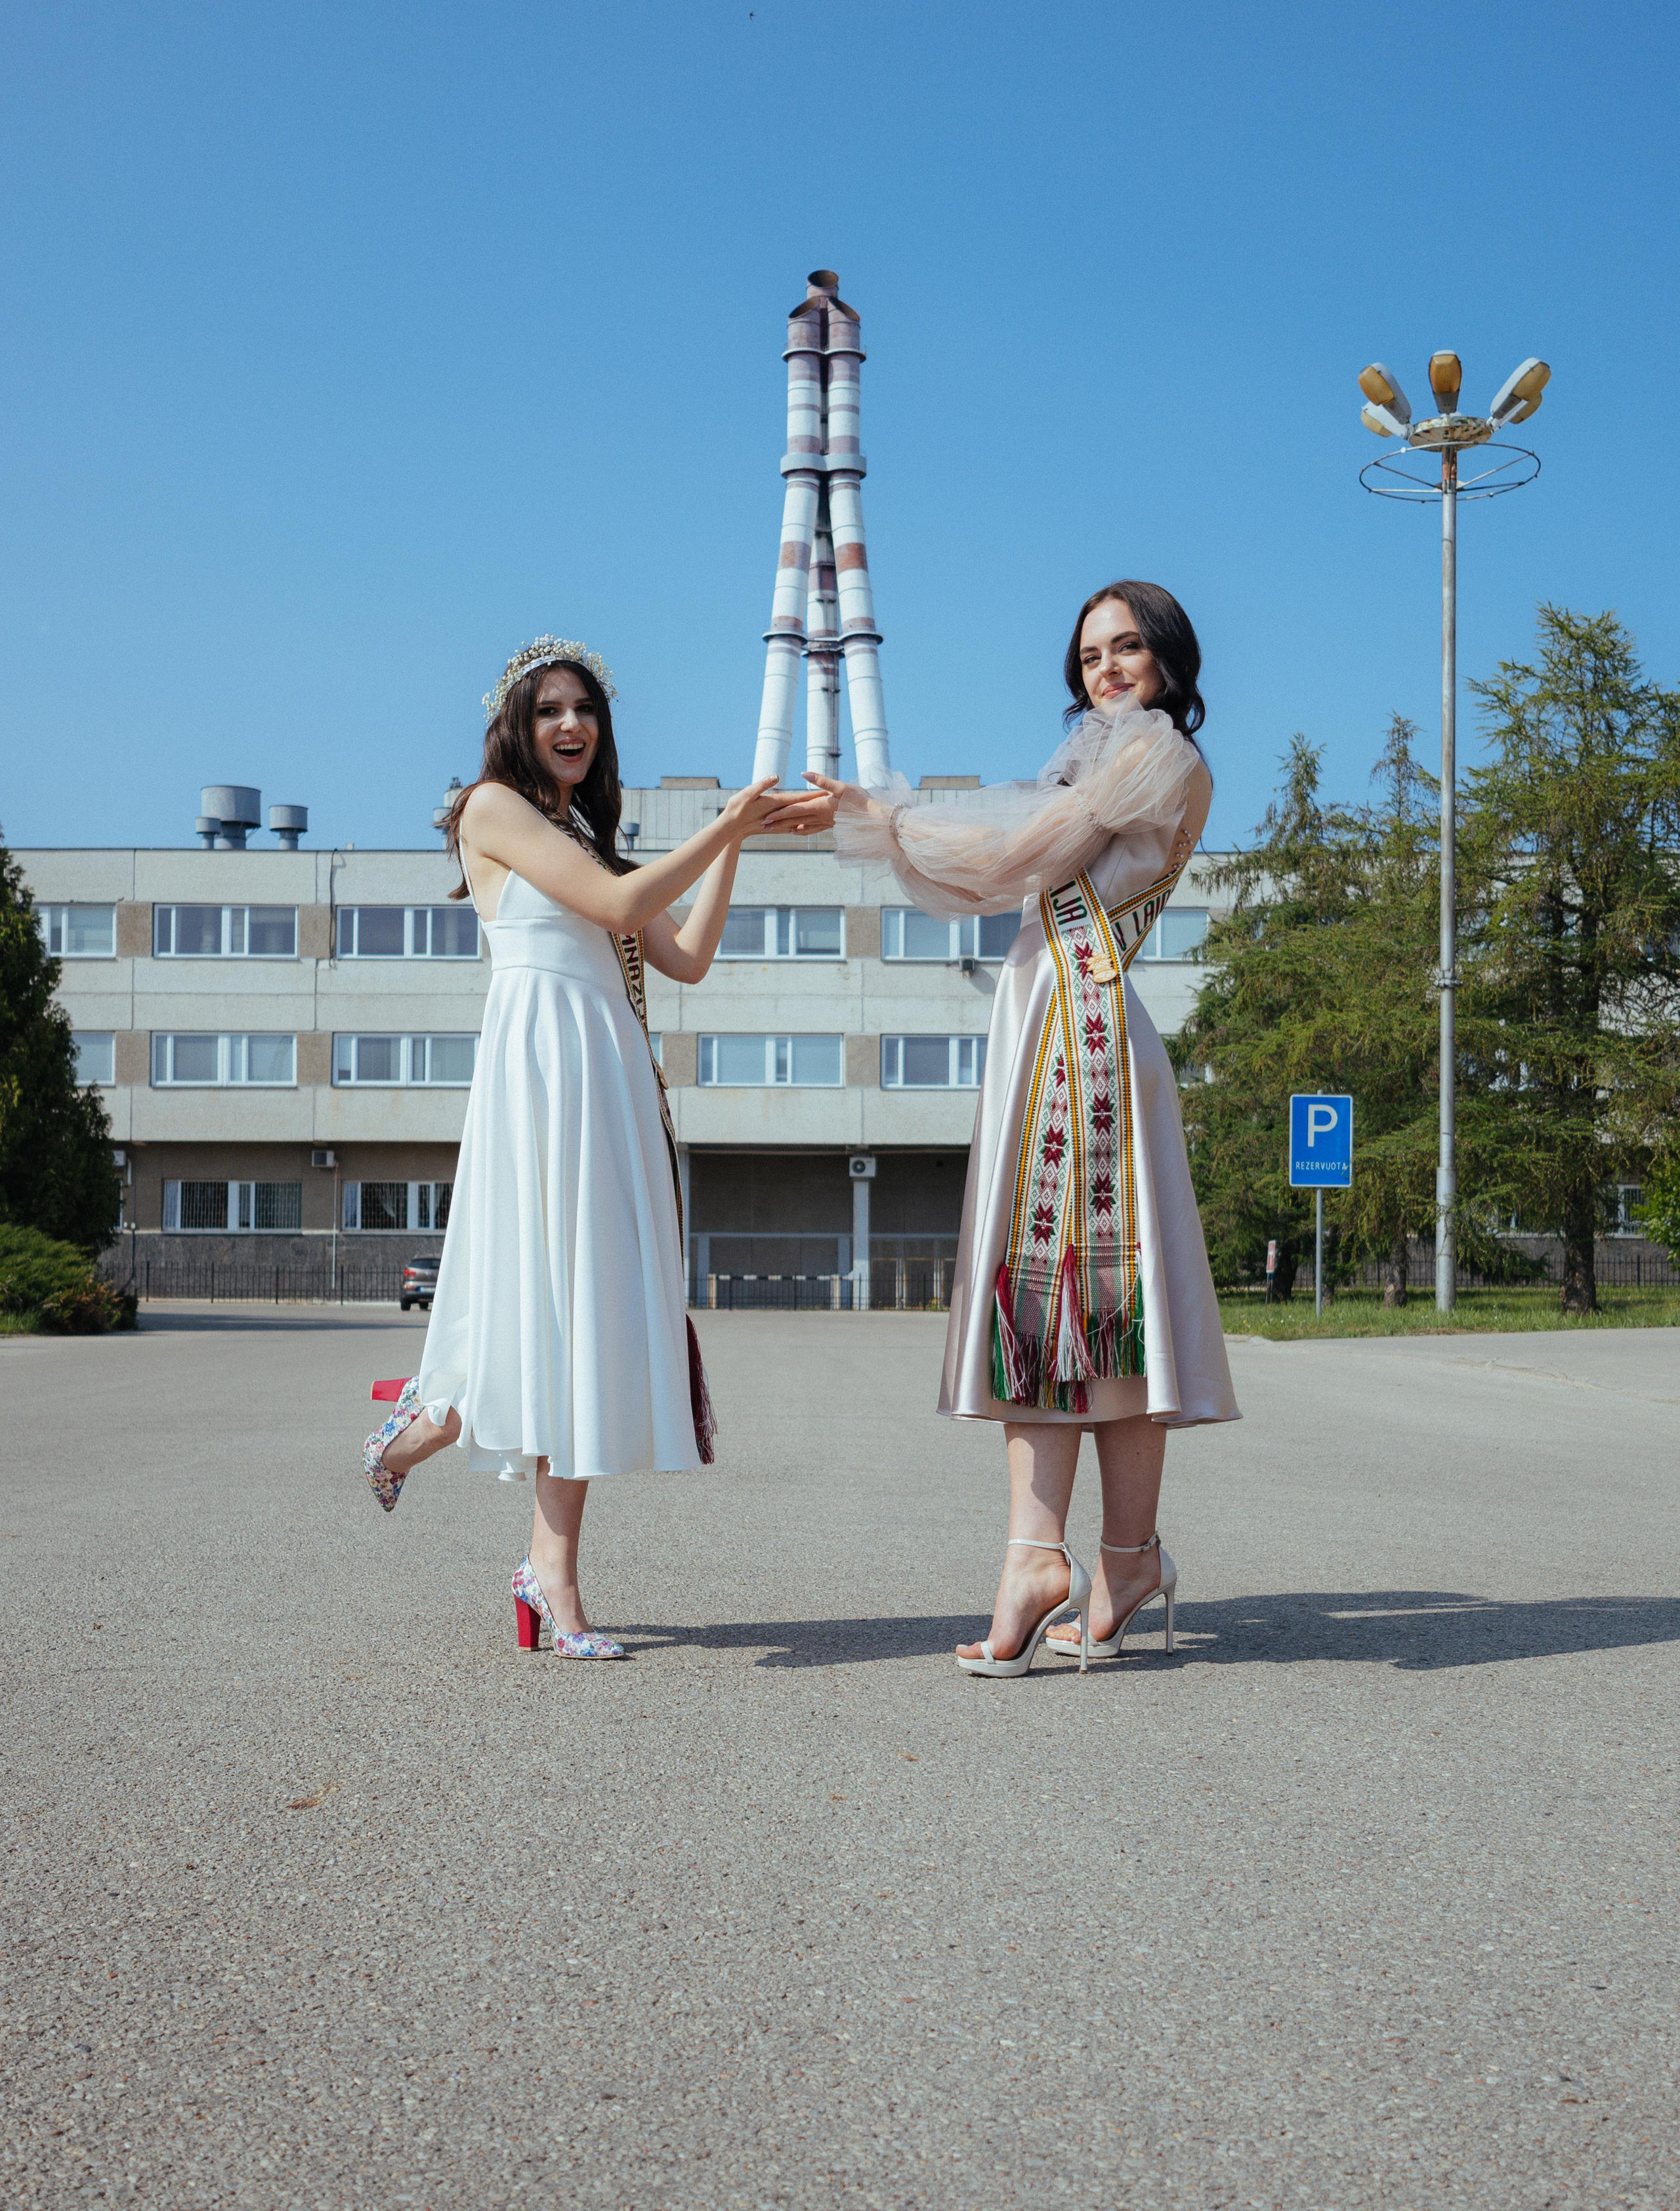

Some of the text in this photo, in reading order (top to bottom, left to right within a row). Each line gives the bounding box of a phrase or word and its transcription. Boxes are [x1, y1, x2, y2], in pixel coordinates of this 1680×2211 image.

[1049, 880, 1087, 926] IJA
[1132, 885, 1175, 937] LAID
[1307, 1104, 1338, 1147] P
[1295, 1161, 1347, 1170] REZERVUOTA
